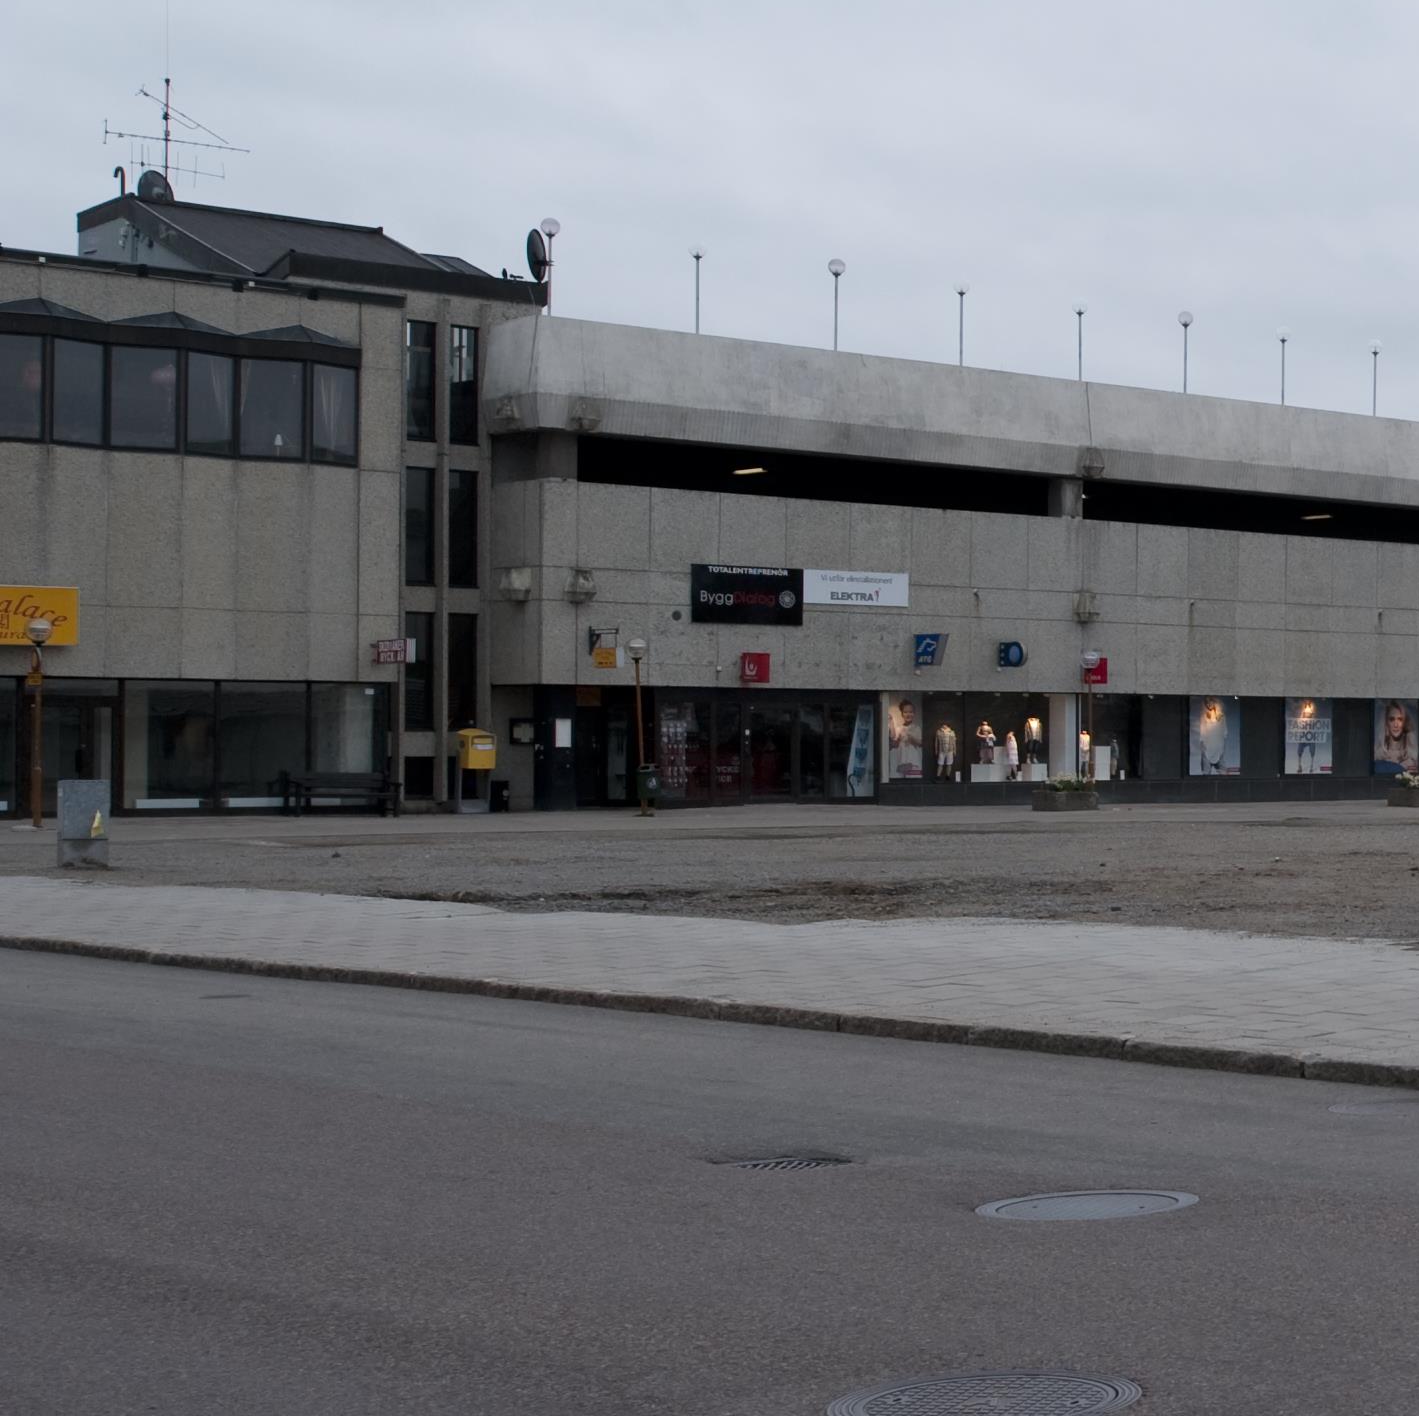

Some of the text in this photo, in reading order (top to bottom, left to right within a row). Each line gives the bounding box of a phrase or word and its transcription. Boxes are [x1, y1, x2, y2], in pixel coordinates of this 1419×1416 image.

[708, 567, 789, 577] TOTALENTREPRENÖR
[830, 591, 874, 601] ELEKTRA
[0, 595, 68, 627] alace
[1288, 720, 1330, 730] FASHION
